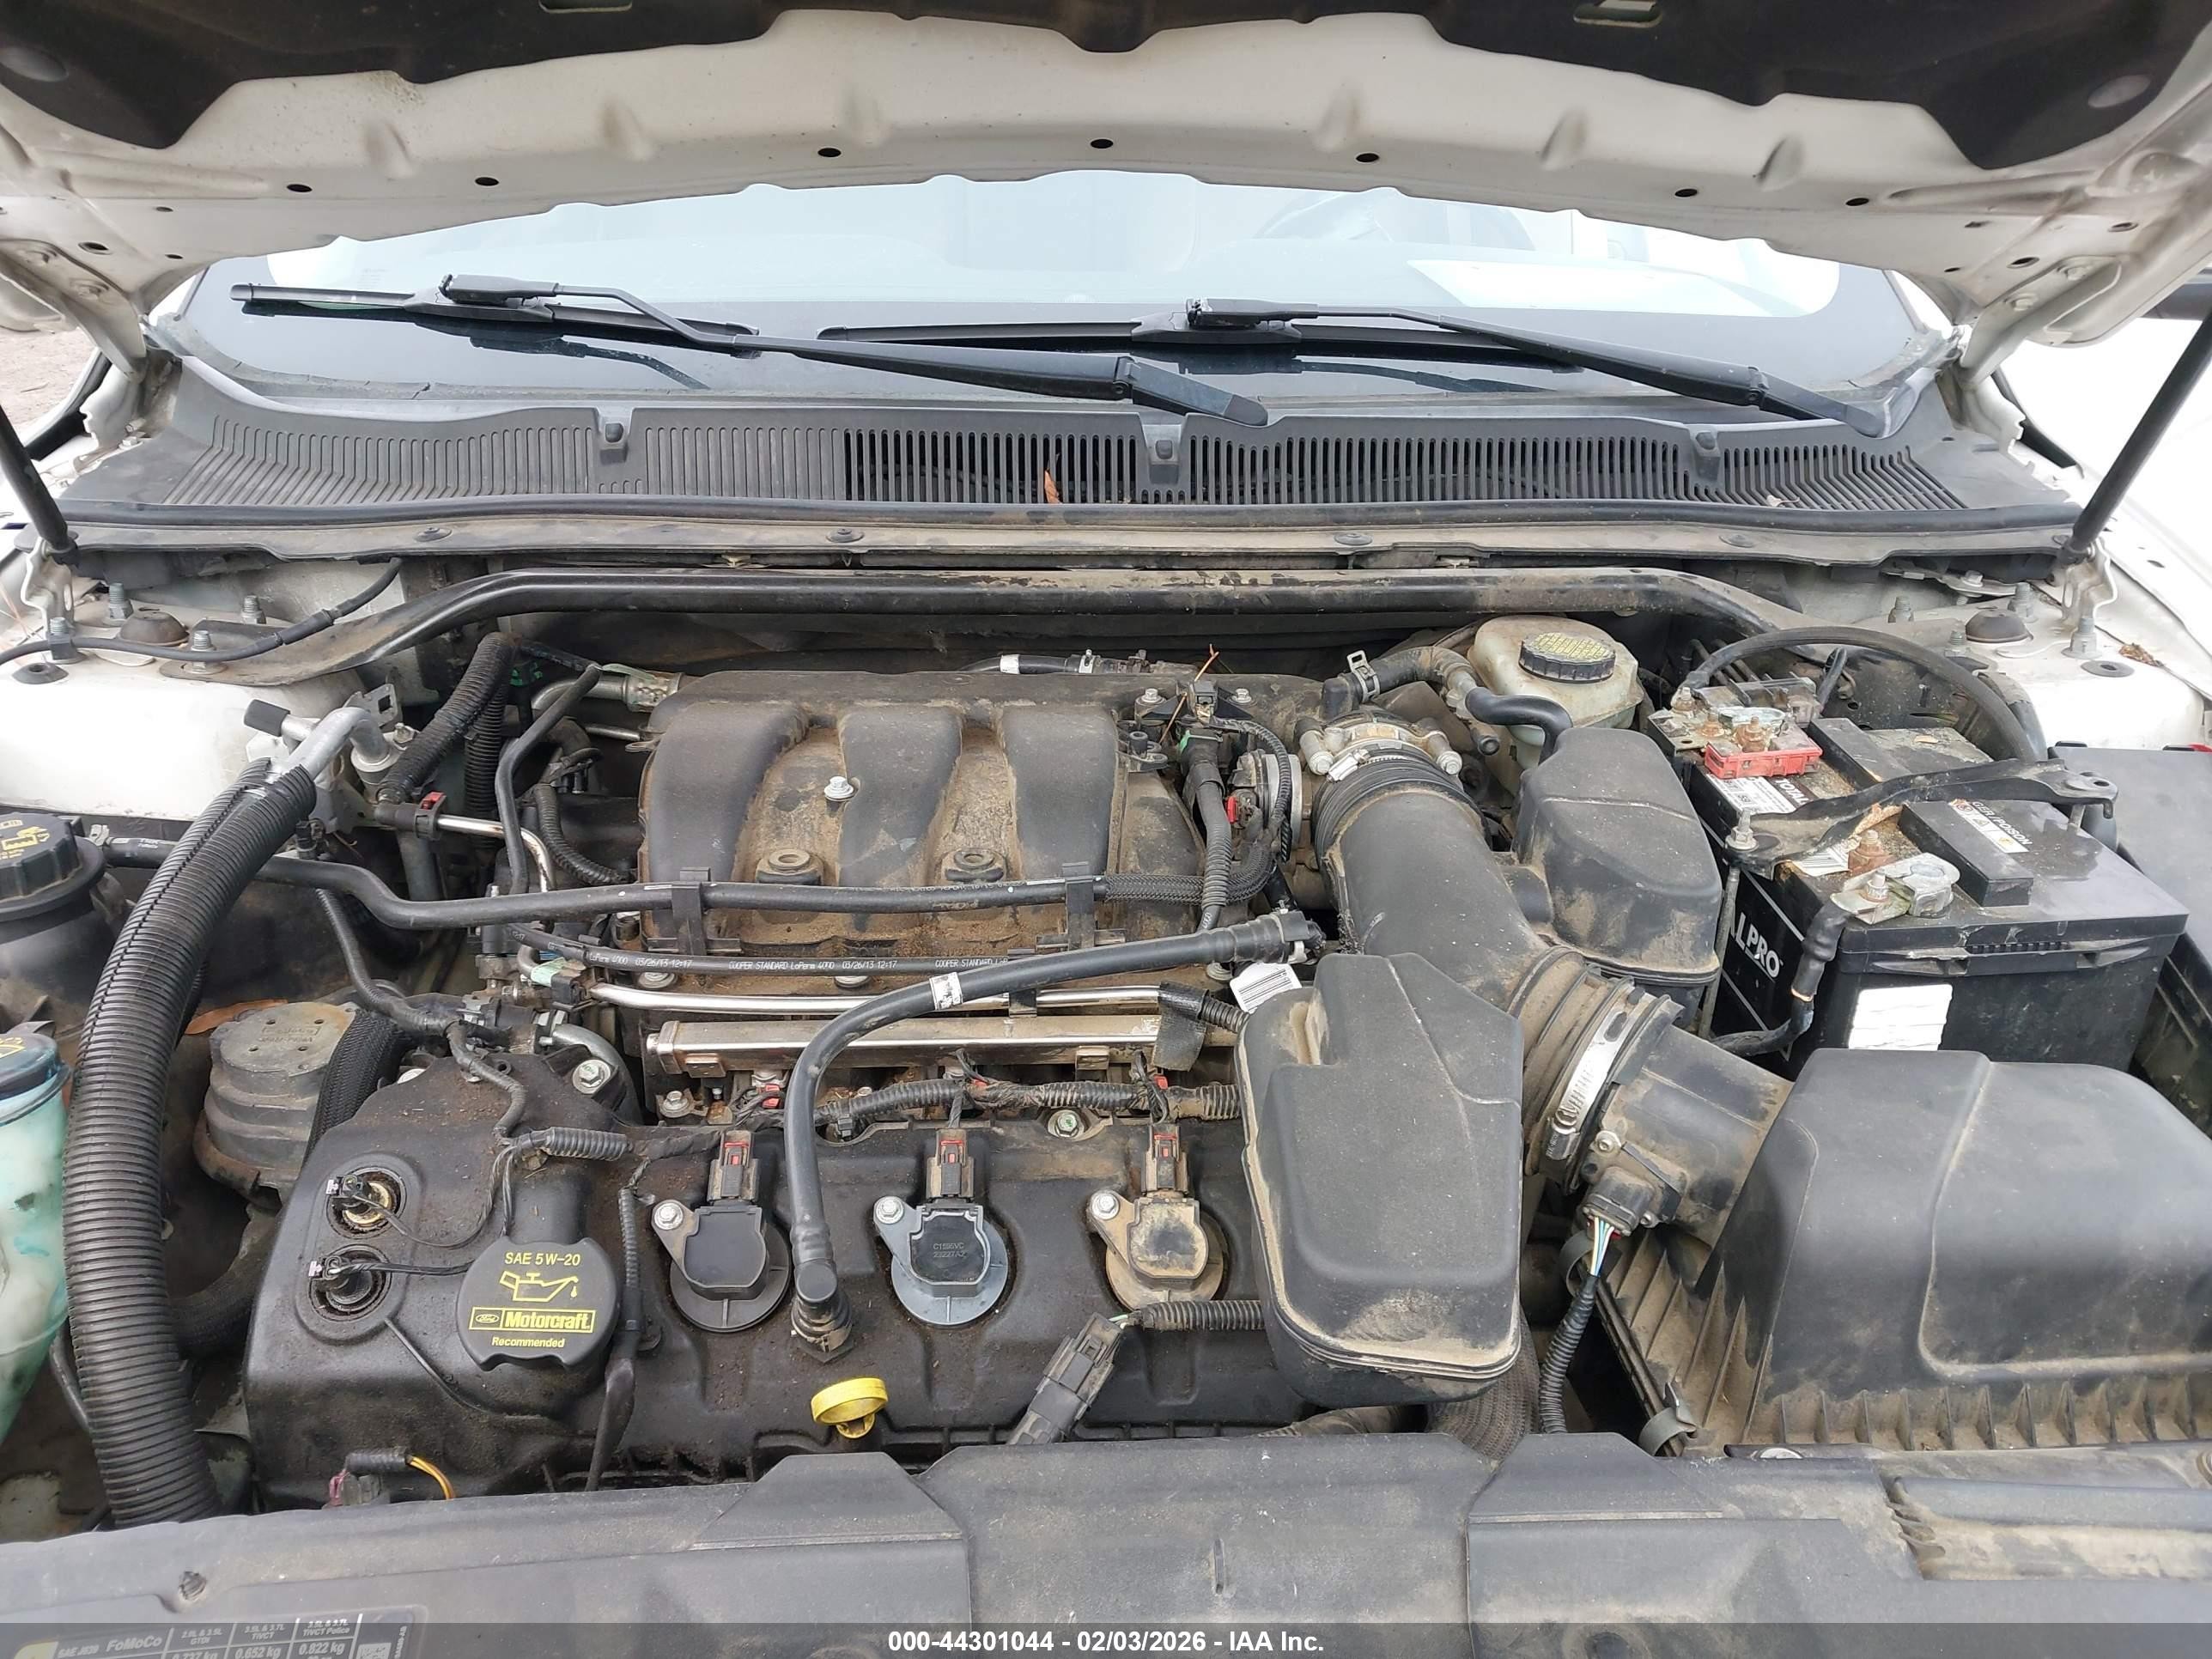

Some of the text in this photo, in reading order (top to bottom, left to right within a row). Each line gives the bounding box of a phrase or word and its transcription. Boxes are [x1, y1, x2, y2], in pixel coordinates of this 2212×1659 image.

[1731, 911, 1780, 978] LPRO
[755, 961, 789, 969] STANDARD
[505, 1252, 532, 1265] SAE
[505, 1311, 590, 1329] Motorcraft
[491, 1336, 566, 1348] Recommended
[106, 1635, 163, 1652] FoMoCo
[299, 1642, 346, 1656] 0.822 kg
